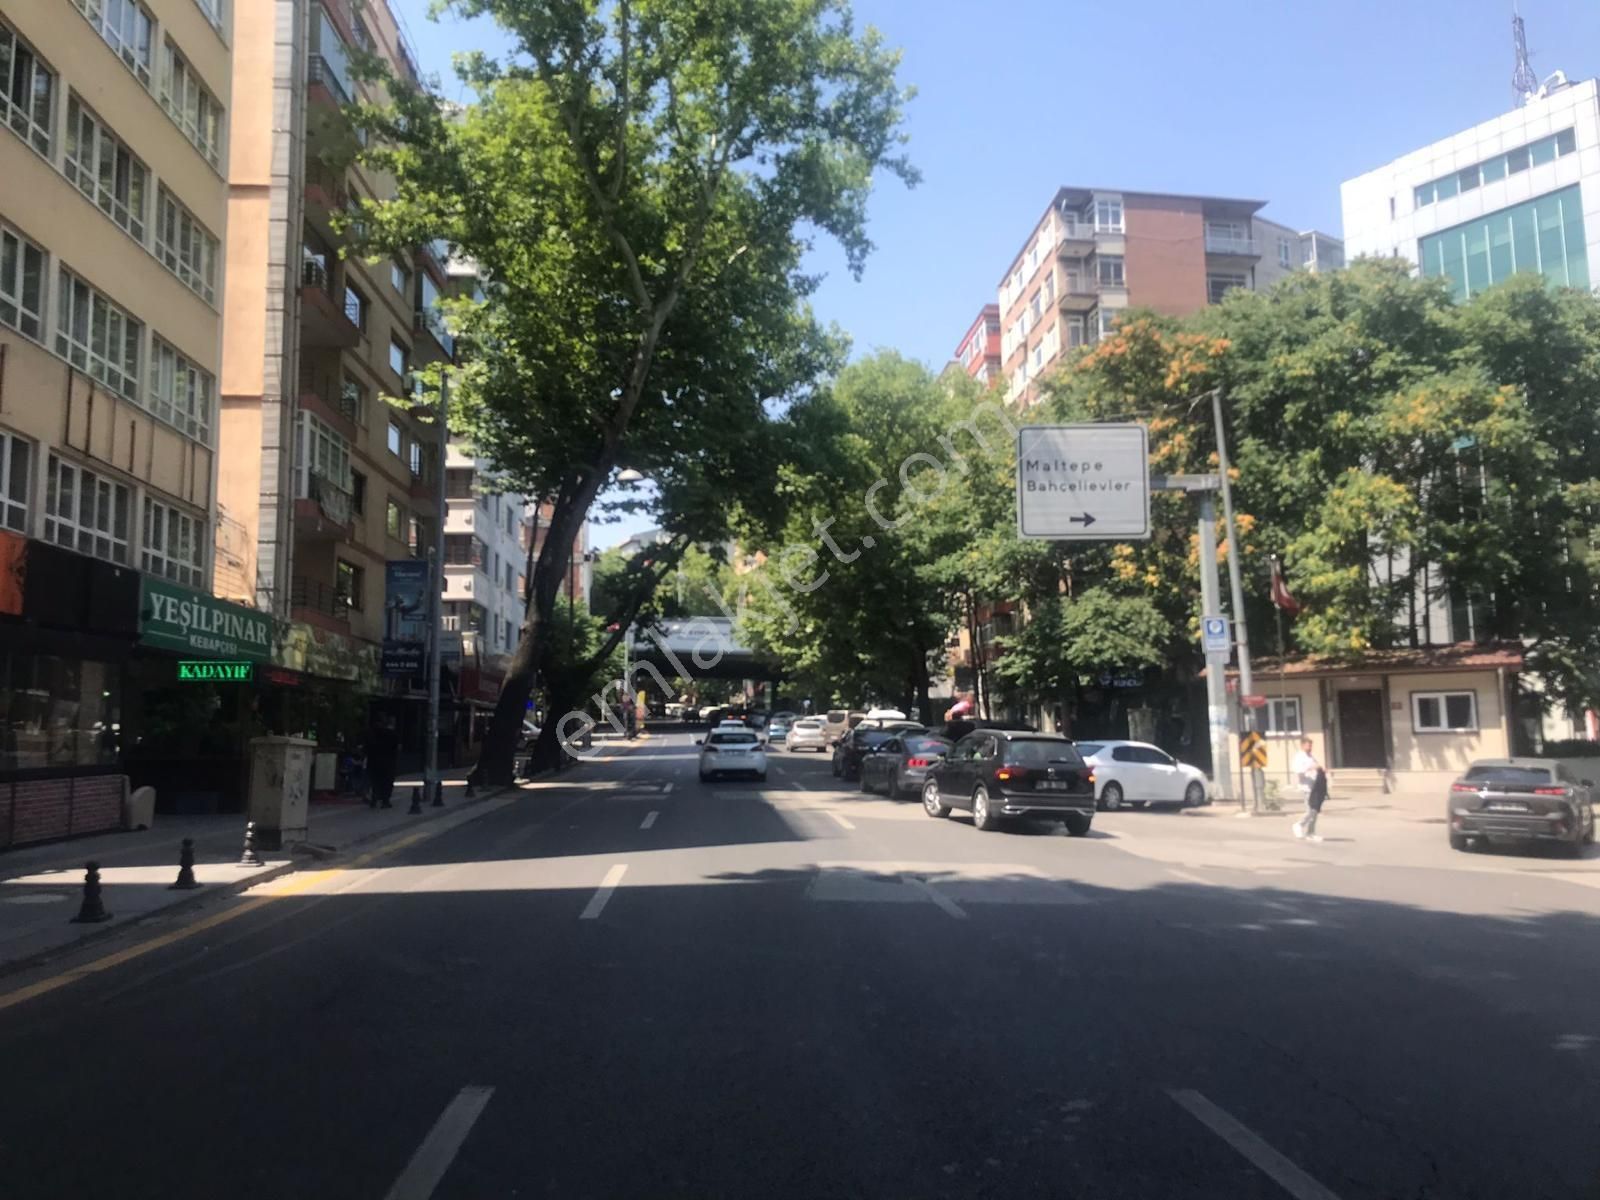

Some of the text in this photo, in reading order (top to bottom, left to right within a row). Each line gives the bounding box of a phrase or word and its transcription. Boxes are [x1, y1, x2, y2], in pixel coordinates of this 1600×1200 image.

[1026, 459, 1103, 474] Maltepe
[149, 592, 267, 646] YEŞİLPINAR
[189, 634, 237, 656] KEBAPÇISI
[180, 665, 250, 679] KADAYIF
